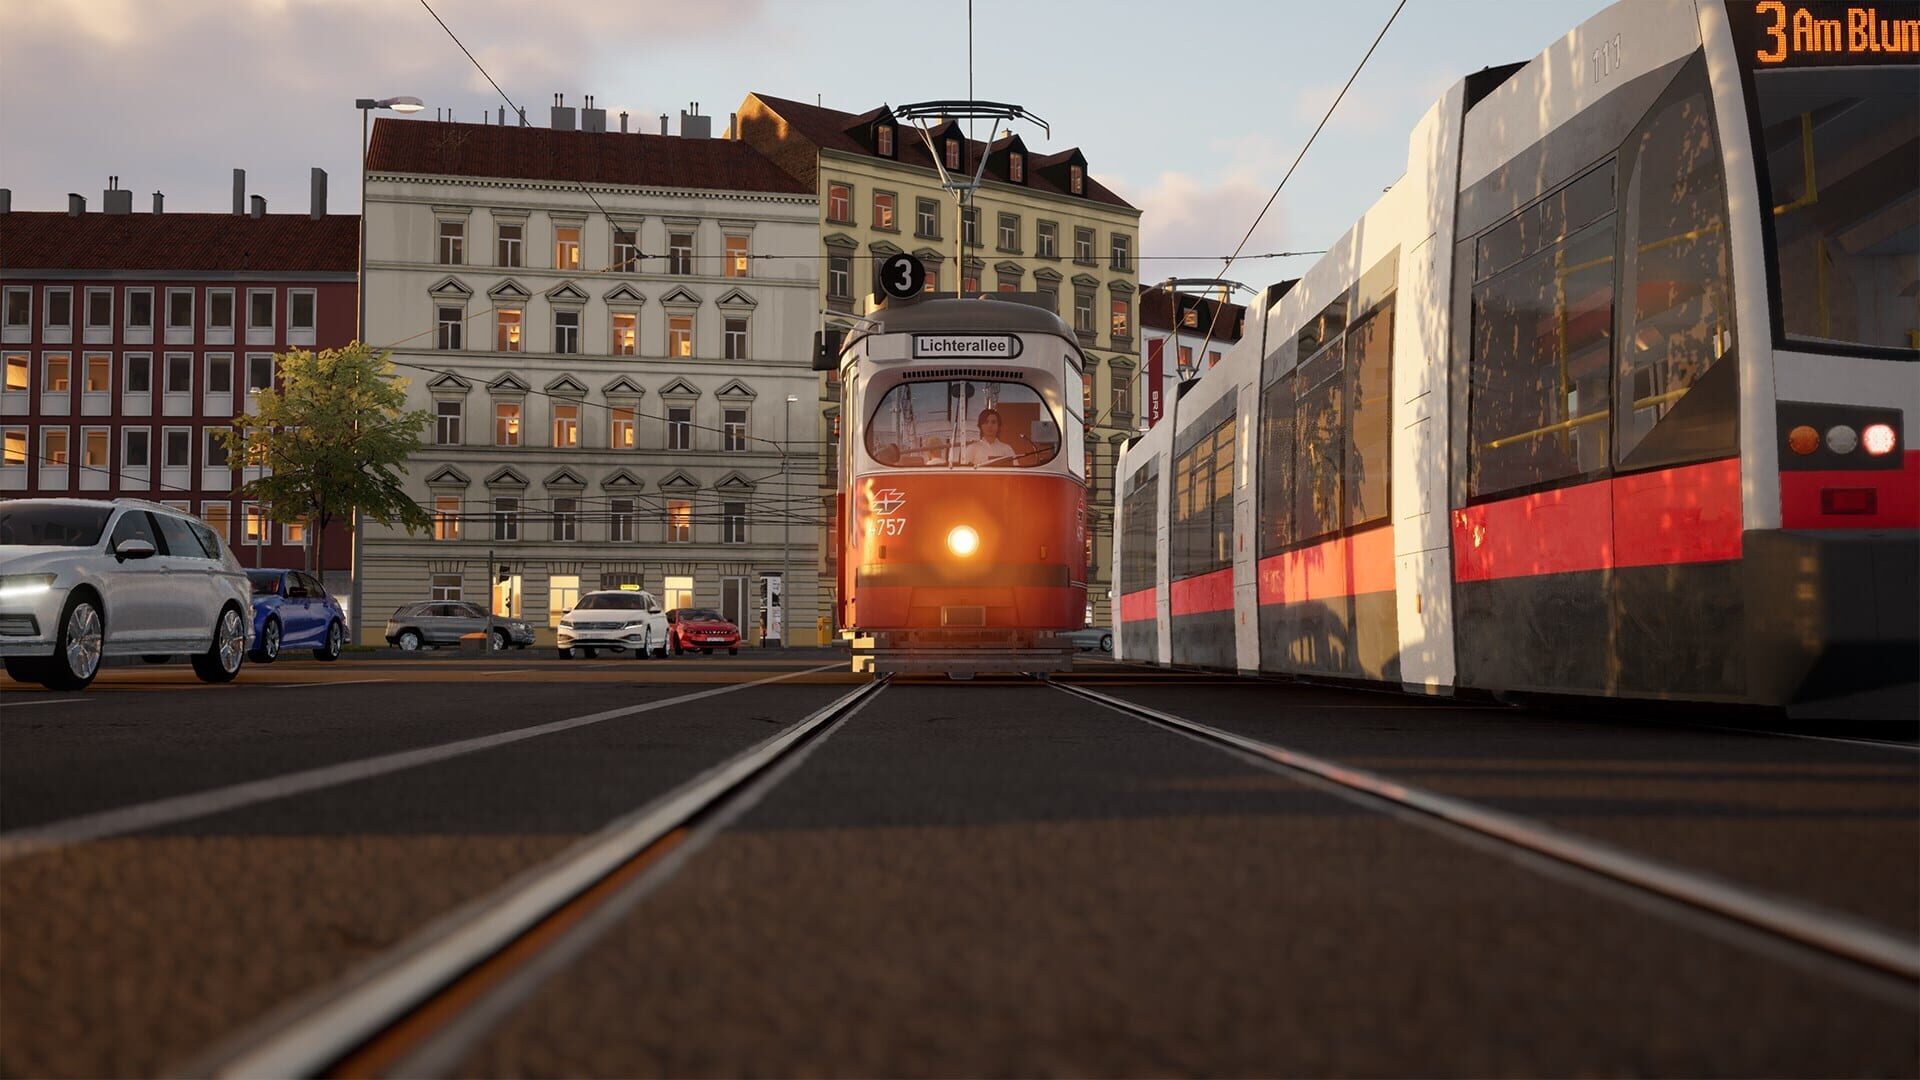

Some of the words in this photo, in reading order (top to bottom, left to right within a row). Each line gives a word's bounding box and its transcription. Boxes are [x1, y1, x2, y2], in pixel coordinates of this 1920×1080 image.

[1756, 0, 1787, 63] 3
[1793, 8, 1842, 52] Am
[1848, 8, 1920, 52] Blum
[895, 258, 912, 291] 3
[920, 339, 1006, 352] Lichterallee
